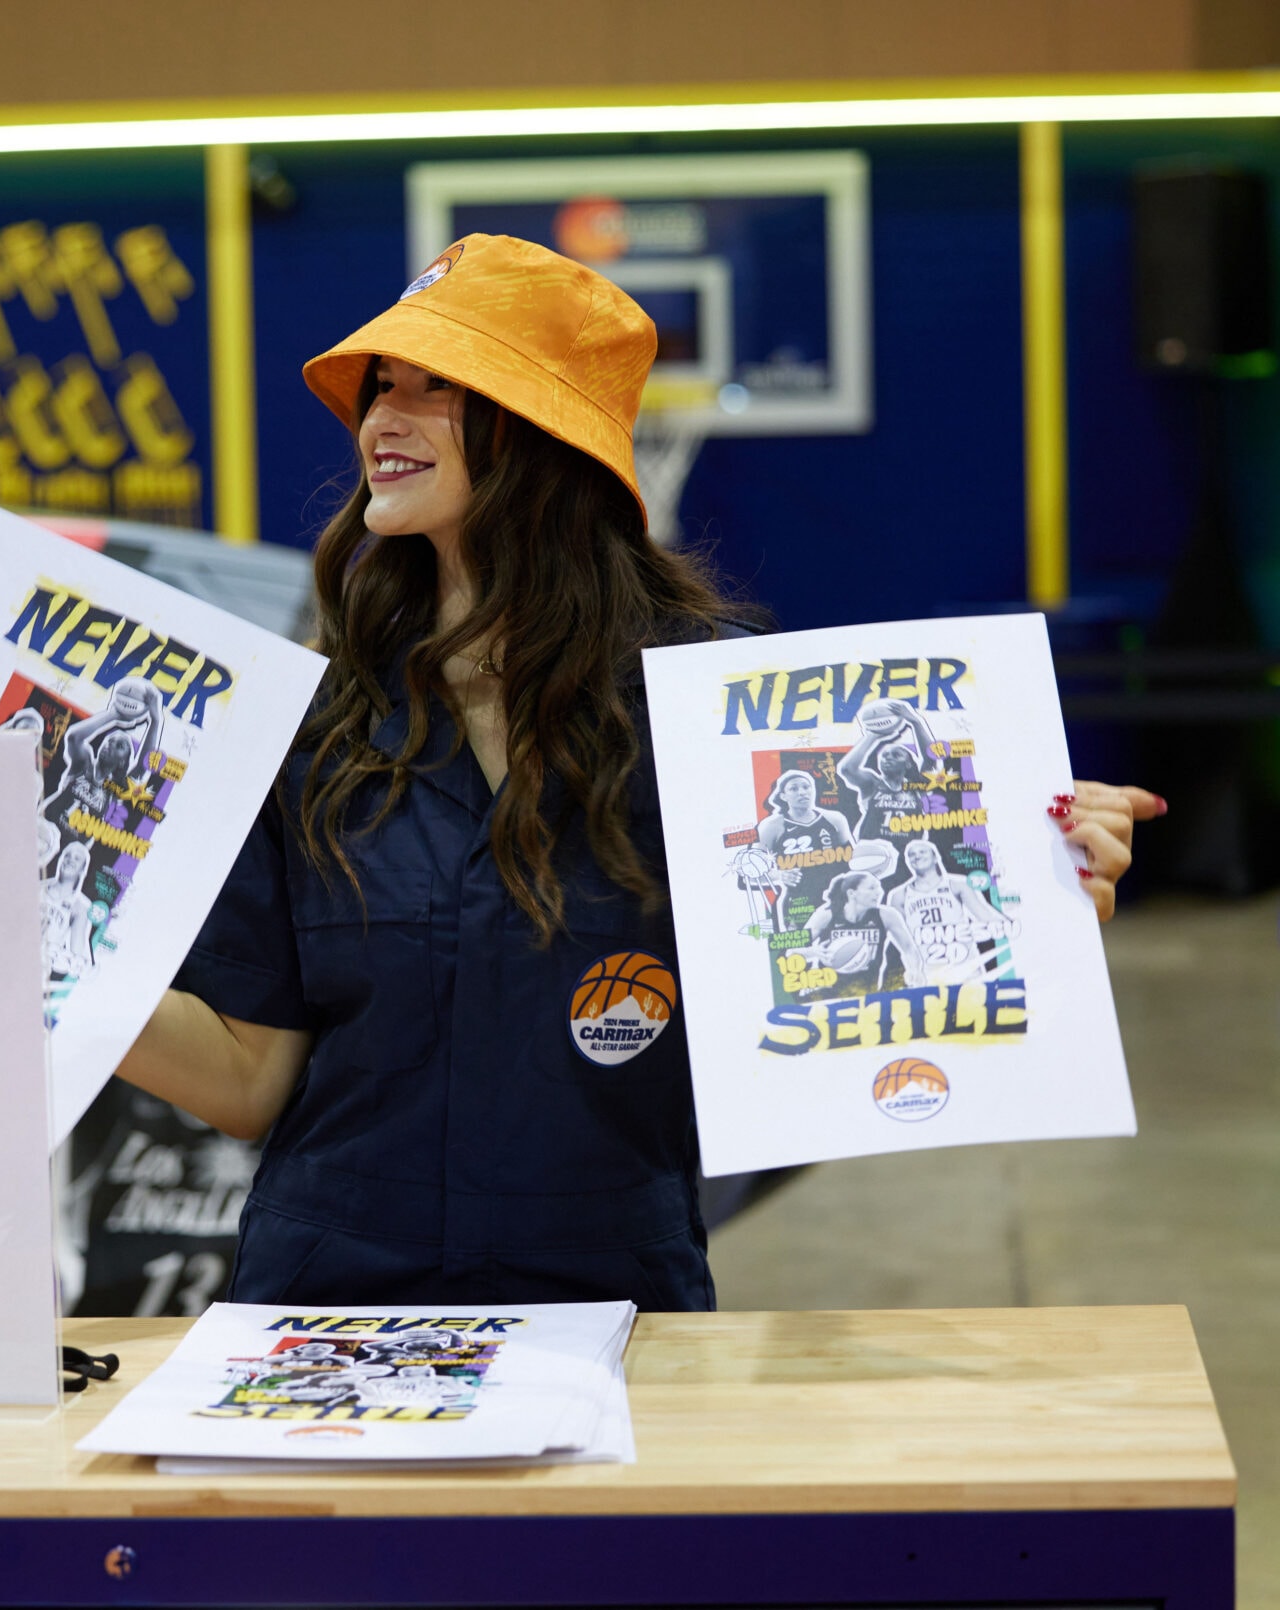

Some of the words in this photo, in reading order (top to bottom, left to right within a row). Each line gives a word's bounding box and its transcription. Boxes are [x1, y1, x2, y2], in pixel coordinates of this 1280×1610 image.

[4, 586, 232, 729] NEVER
[720, 657, 967, 735] NEVER
[889, 808, 988, 833] OGWUMIKE
[783, 836, 813, 855] 22
[777, 846, 852, 870] WILSON
[920, 908, 942, 925] 20
[769, 937, 810, 950] CHAMP
[776, 954, 806, 974] 10
[783, 967, 838, 992] BIRD
[758, 978, 1028, 1056] SETTLE
[590, 1042, 618, 1051] ALL-STAR
[618, 1042, 640, 1051] GARAGE
[264, 1316, 524, 1334] NEVER
